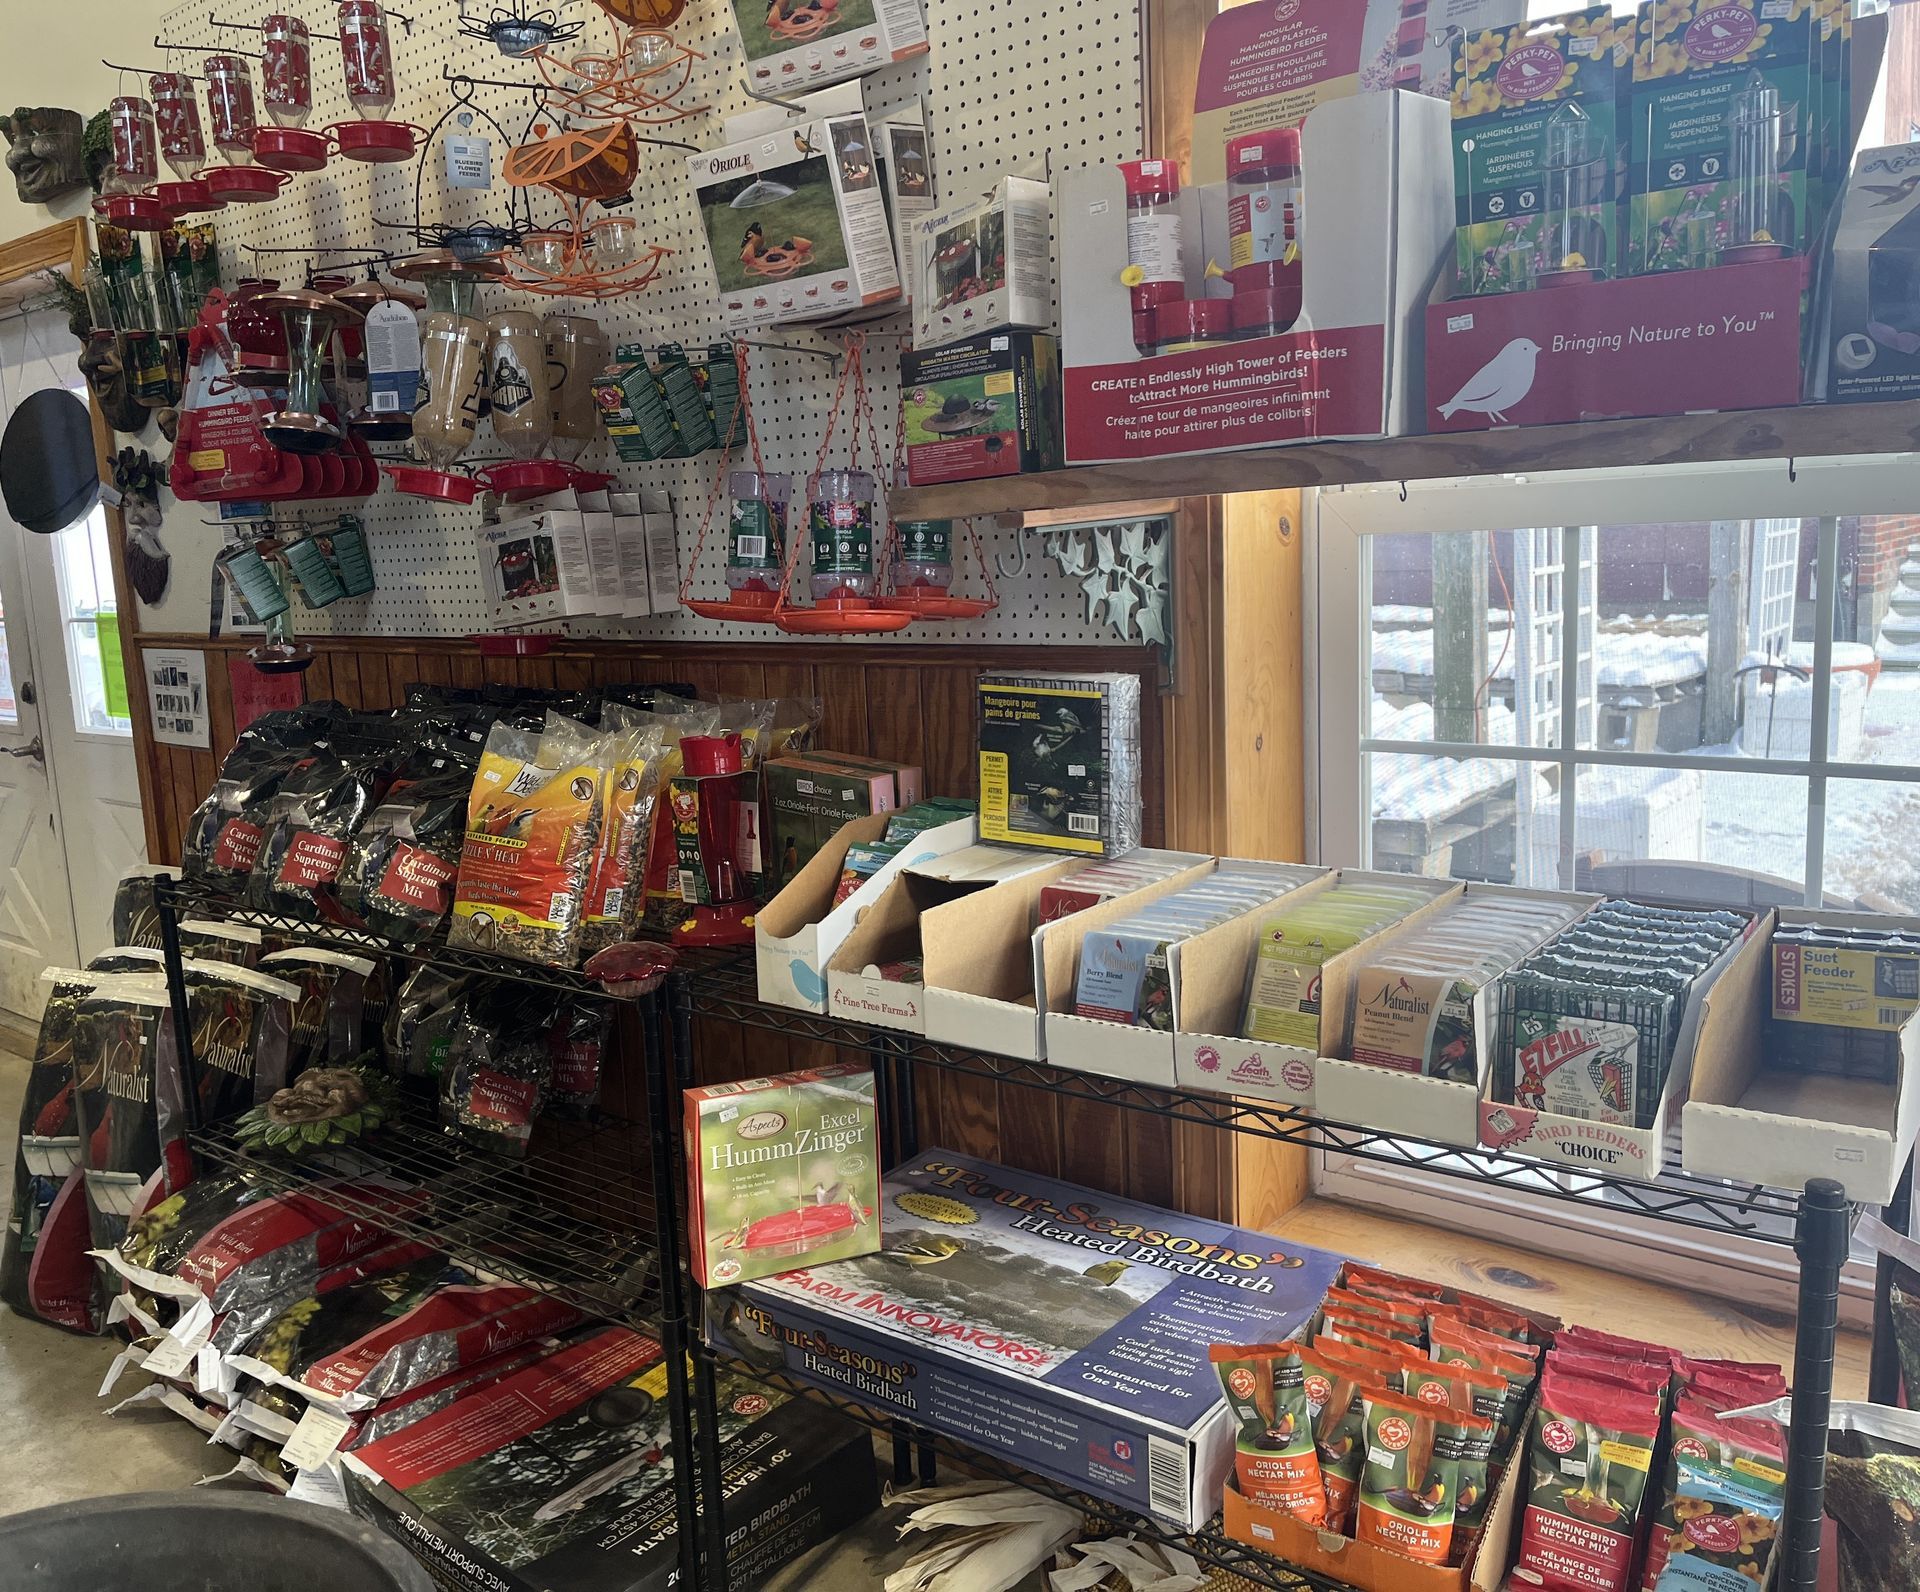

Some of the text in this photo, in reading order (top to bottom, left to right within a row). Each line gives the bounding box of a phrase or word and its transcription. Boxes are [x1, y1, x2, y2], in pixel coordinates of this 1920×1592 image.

[1240, 25, 1318, 54] HANGING PLASTIC
[1259, 21, 1302, 39] MODULAR
[1230, 33, 1328, 66] HUMMINGBIRD FEEDER
[1223, 58, 1327, 93] SUSPENDUE EN PLASTIQUE
[1228, 50, 1325, 82] MANGEOIRE MODULAIRE
[1236, 72, 1313, 98] POUR LES COLIBRIS
[1659, 83, 1732, 103] HANGING BASKET
[1476, 120, 1543, 141] HANGING BASKET
[1670, 124, 1719, 139] SUSPENDUS
[454, 159, 484, 167] BLUEBIRD
[1488, 159, 1533, 174] SUSPENDUS
[1552, 330, 1622, 354] Bringing
[1628, 324, 1690, 345] Nature
[1697, 322, 1716, 337] to
[1091, 347, 1348, 392] CREATE Endlessly High Tower of Feeders
[1139, 366, 1308, 403] Attract More Hummingbirds!
[1106, 388, 1331, 427] Créez tour de mangeoires infiniment
[1154, 405, 1316, 438] pour attirer plus de colibris!
[984, 696, 1037, 709] Mangeoire pour
[985, 708, 1041, 721] pains de graines
[985, 755, 1004, 763] PERMET
[798, 781, 833, 796] BIRDS choice
[821, 806, 841, 819] Oriole
[293, 852, 338, 872] Supreme
[297, 839, 343, 861] Cardinal
[494, 849, 521, 865] HEAT
[299, 867, 320, 882] Mix
[401, 853, 452, 881] Cardinal
[401, 886, 425, 900] Mix
[1803, 950, 1839, 964] Suet
[1086, 968, 1123, 980] Berry Blend
[1781, 950, 1797, 1006] STOKES
[1804, 964, 1856, 979] Feeder
[842, 996, 909, 1017] Pine Tree Farms
[1359, 983, 1430, 1015] Naturalist
[1364, 1007, 1414, 1023] Peanut Blend
[76, 1038, 150, 1104] Naturalist
[1231, 1059, 1270, 1078] Heath
[1559, 1067, 1577, 1076] Holds
[487, 1100, 511, 1116] Mix
[820, 1107, 861, 1130] Excel
[742, 1118, 782, 1135] Aspects
[1535, 1125, 1648, 1160] BIRD FEEDERS
[1011, 1213, 1274, 1296] Heated Birdbath
[1172, 1300, 1246, 1324] heating element
[1179, 1295, 1273, 1322] oasis with concealed
[1186, 1288, 1288, 1318] Attractive sand coated
[773, 1268, 1040, 1366] FARM INNOVATORS
[1149, 1319, 1195, 1335] controlled
[1158, 1313, 1235, 1338] Thermostatically
[1141, 1325, 1189, 1342] only when
[1116, 1344, 1196, 1370] during off season
[1124, 1338, 1202, 1364] Cord tucks away
[1108, 1349, 1194, 1379] hidden from sight
[803, 1352, 918, 1411] Heated Birdbath
[1081, 1372, 1143, 1397] One Year
[1092, 1363, 1193, 1399] Guaranteed for
[935, 1411, 1016, 1447] Guaranteed for One Year
[1247, 1468, 1306, 1480] NECTAR MIX
[1255, 1460, 1293, 1471] ORIOLE
[750, 1481, 812, 1532] BIRDBATH
[1255, 1490, 1304, 1501] MÉLANGE DE
[1278, 1497, 1315, 1509] D'ORIOLE
[757, 1513, 791, 1541] STAND
[1375, 1525, 1441, 1549] NECTAR MIX
[1388, 1520, 1429, 1538] ORIOLE
[1535, 1514, 1618, 1547] HUMMINGBIRD
[1540, 1525, 1587, 1548] NECTAR
[1588, 1541, 1611, 1555] MIX
[444, 1545, 486, 1581] SUPPORT
[1525, 1554, 1562, 1574] NECTAR
[1562, 1565, 1576, 1577] DE
[1577, 1572, 1615, 1589] COLIBRI
[1540, 1549, 1601, 1576] MÉLANGE DE
[1707, 1579, 1718, 1589] DE
